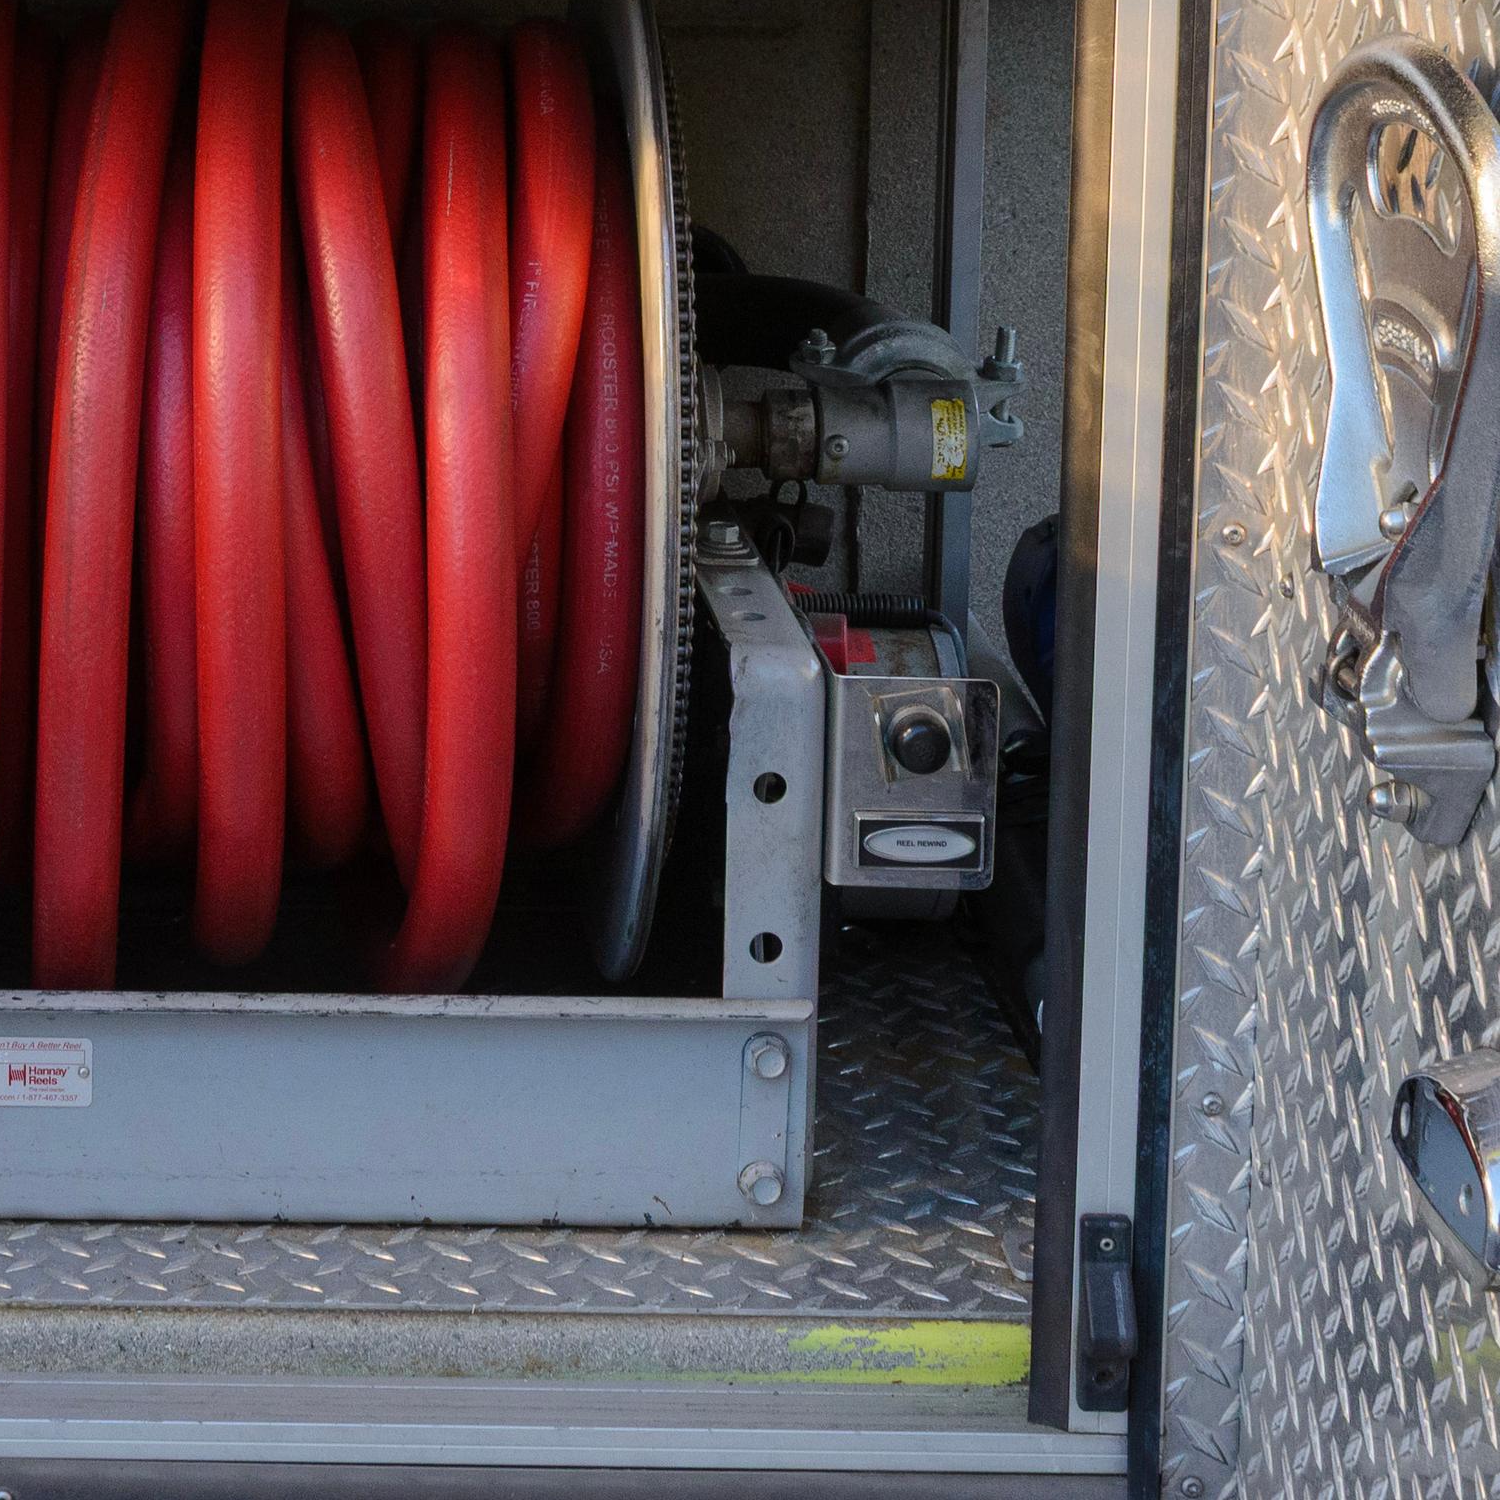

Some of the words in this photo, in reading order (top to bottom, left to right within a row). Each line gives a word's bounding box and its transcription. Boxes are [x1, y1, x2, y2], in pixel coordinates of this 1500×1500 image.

[917, 840, 948, 848] REWIND
[11, 1041, 27, 1050] Buy
[28, 1041, 37, 1049] A
[37, 1041, 61, 1049] Better
[62, 1042, 82, 1050] Reel
[28, 1065, 67, 1078] Hannay
[28, 1075, 58, 1085] Reels
